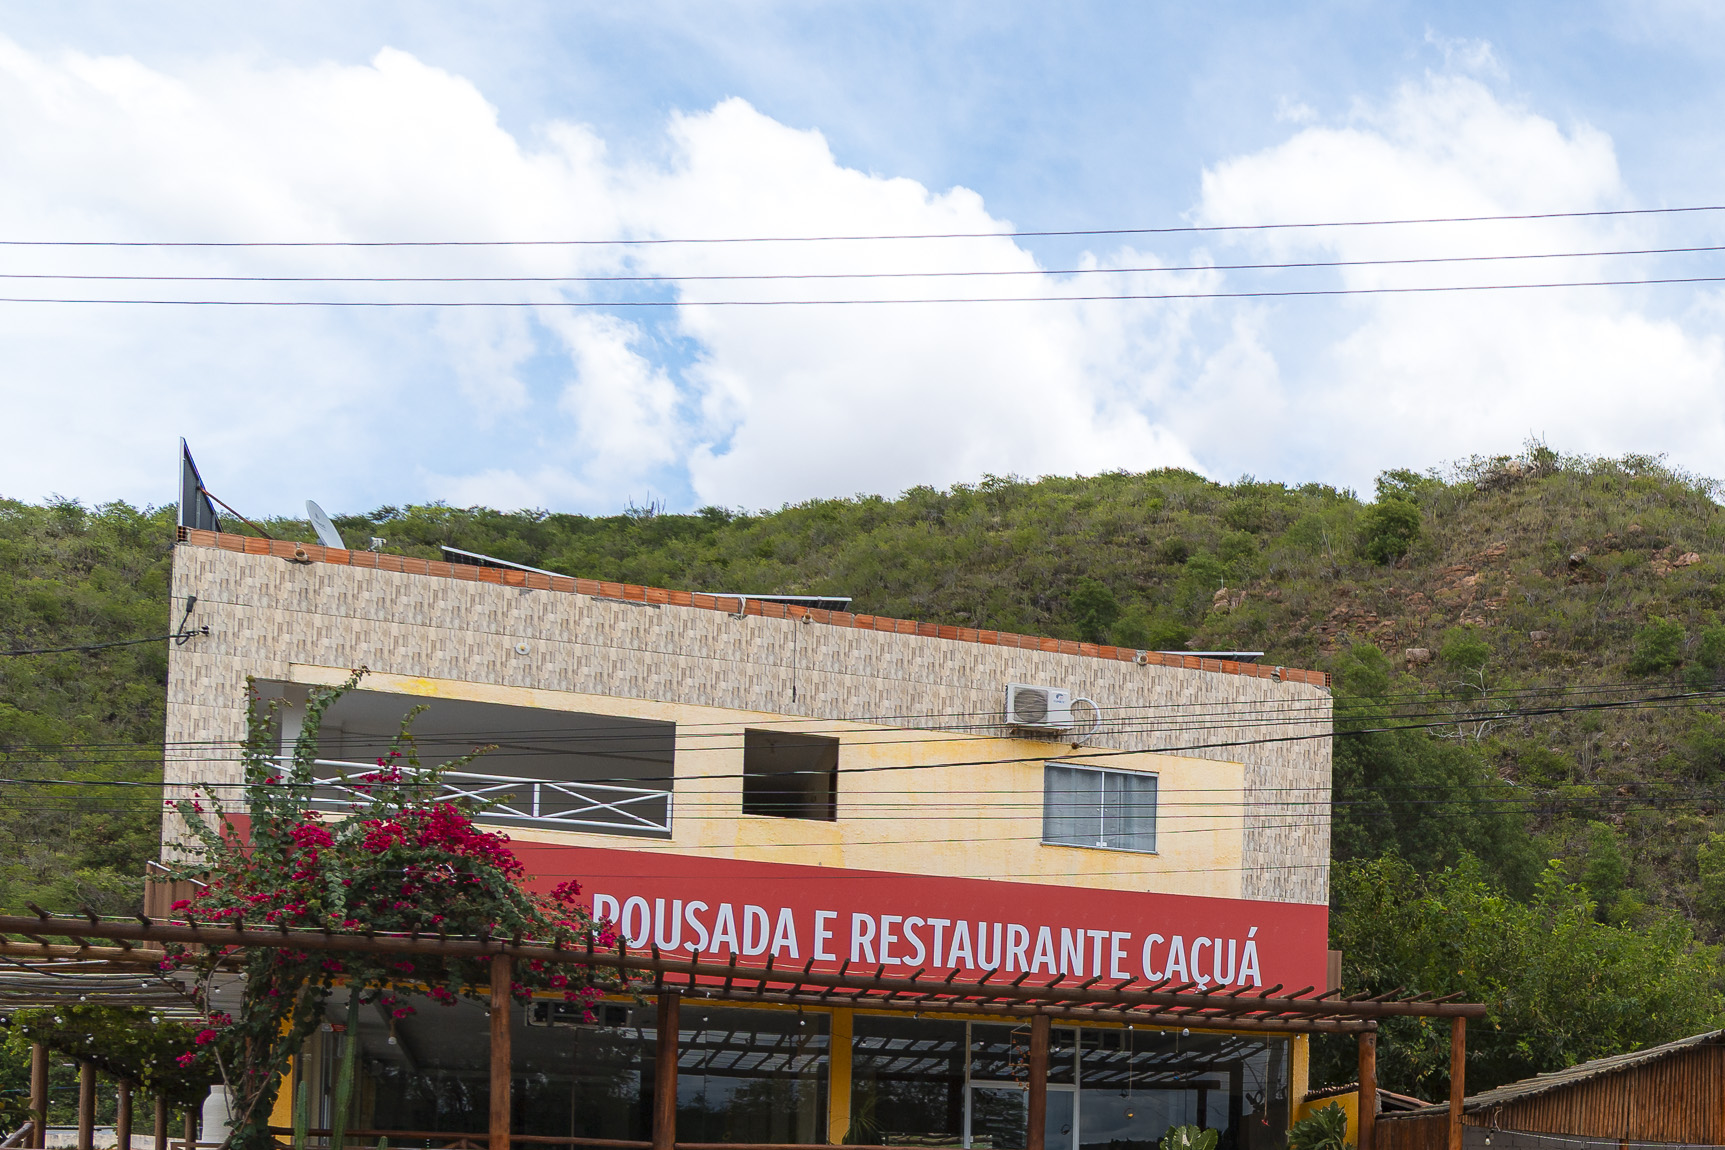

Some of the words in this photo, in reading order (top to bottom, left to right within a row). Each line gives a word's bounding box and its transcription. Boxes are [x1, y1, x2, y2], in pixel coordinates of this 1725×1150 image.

[592, 893, 800, 960] POUSADA
[813, 909, 839, 963] E
[850, 911, 1132, 980] RESTAURANTE
[1141, 926, 1263, 991] CAÇUÁ
